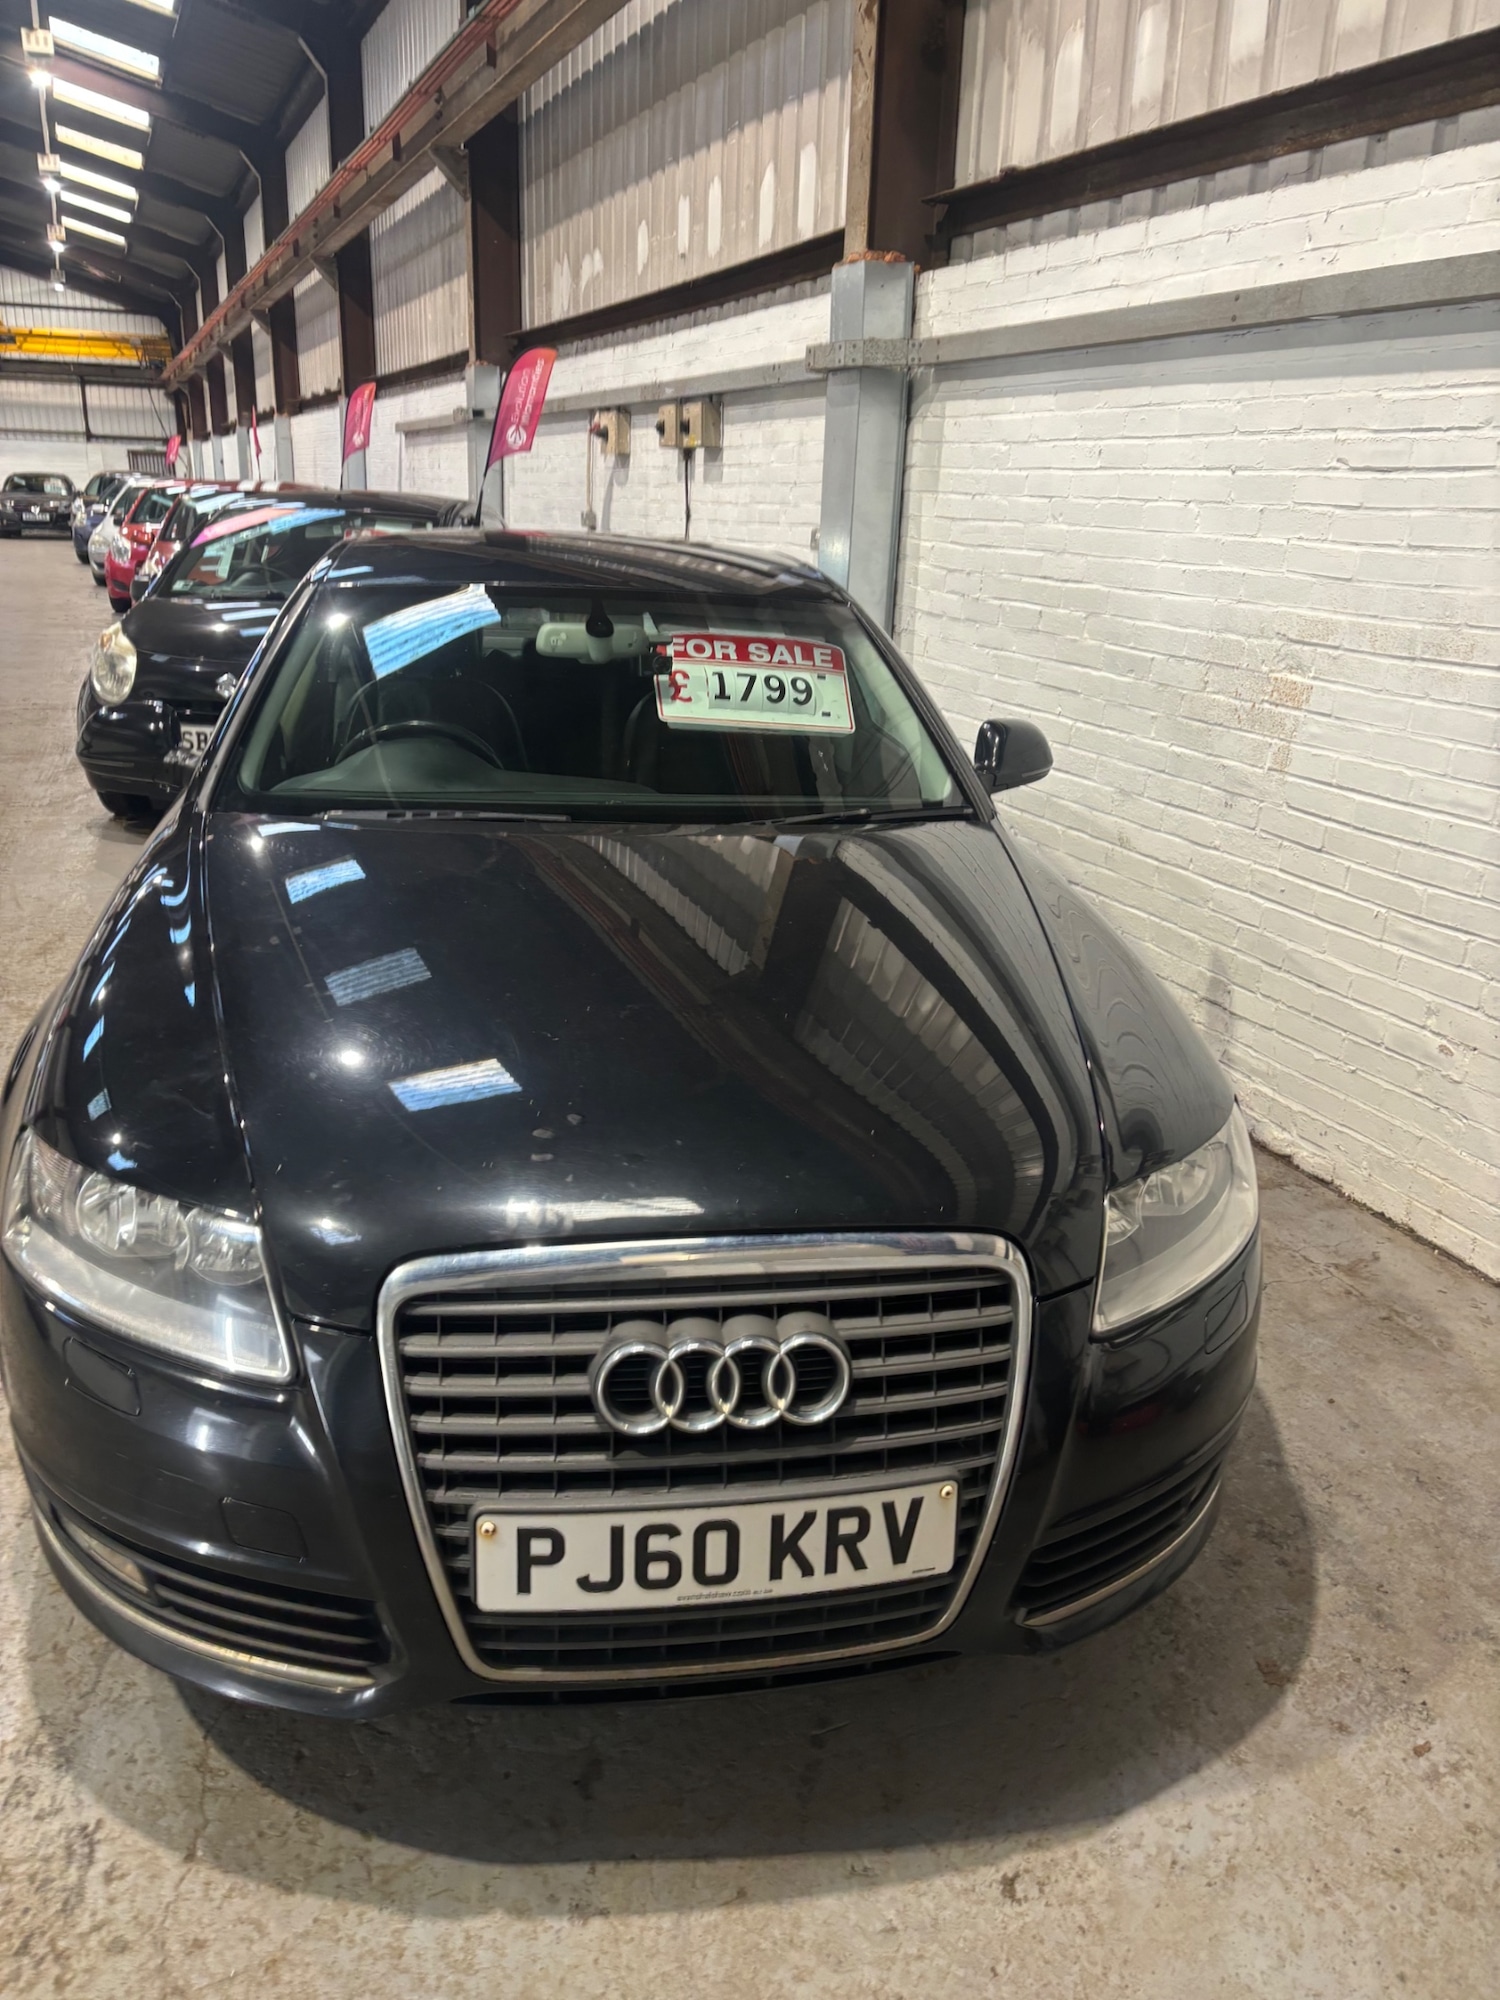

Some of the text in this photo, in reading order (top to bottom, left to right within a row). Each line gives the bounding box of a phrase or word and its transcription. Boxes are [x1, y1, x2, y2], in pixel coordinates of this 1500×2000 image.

[672, 636, 834, 668] FOR SALE
[712, 671, 813, 706] 1799
[516, 1496, 925, 1596] PJ60 KRV
